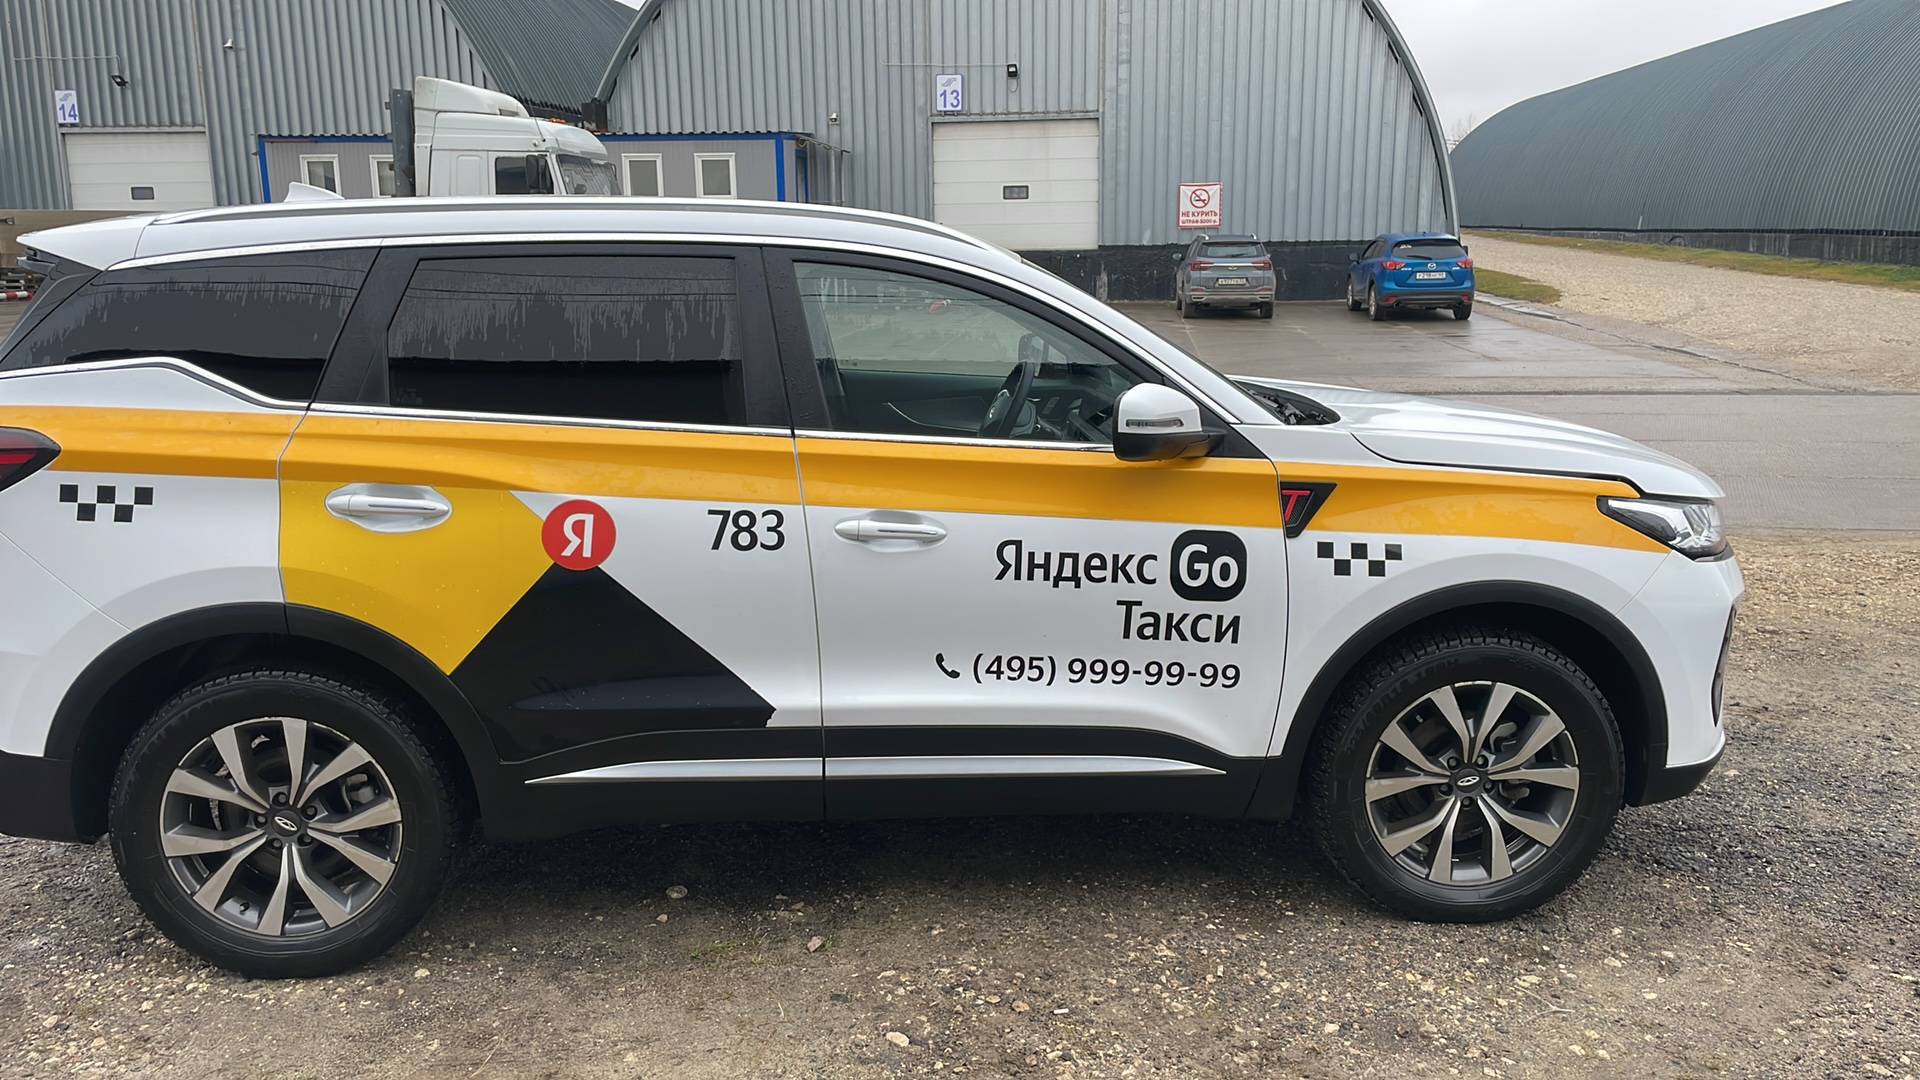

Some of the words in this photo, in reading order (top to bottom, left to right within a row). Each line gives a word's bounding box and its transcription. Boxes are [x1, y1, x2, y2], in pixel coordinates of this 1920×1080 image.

[59, 103, 78, 121] 14
[939, 89, 960, 109] 13
[561, 513, 595, 558] Я
[707, 509, 786, 552] 783
[995, 539, 1158, 589] Яндекс
[1177, 543, 1240, 589] Go
[1116, 600, 1241, 644] Такси
[973, 653, 1057, 686] (495)
[1067, 657, 1242, 689] 999-99-99
